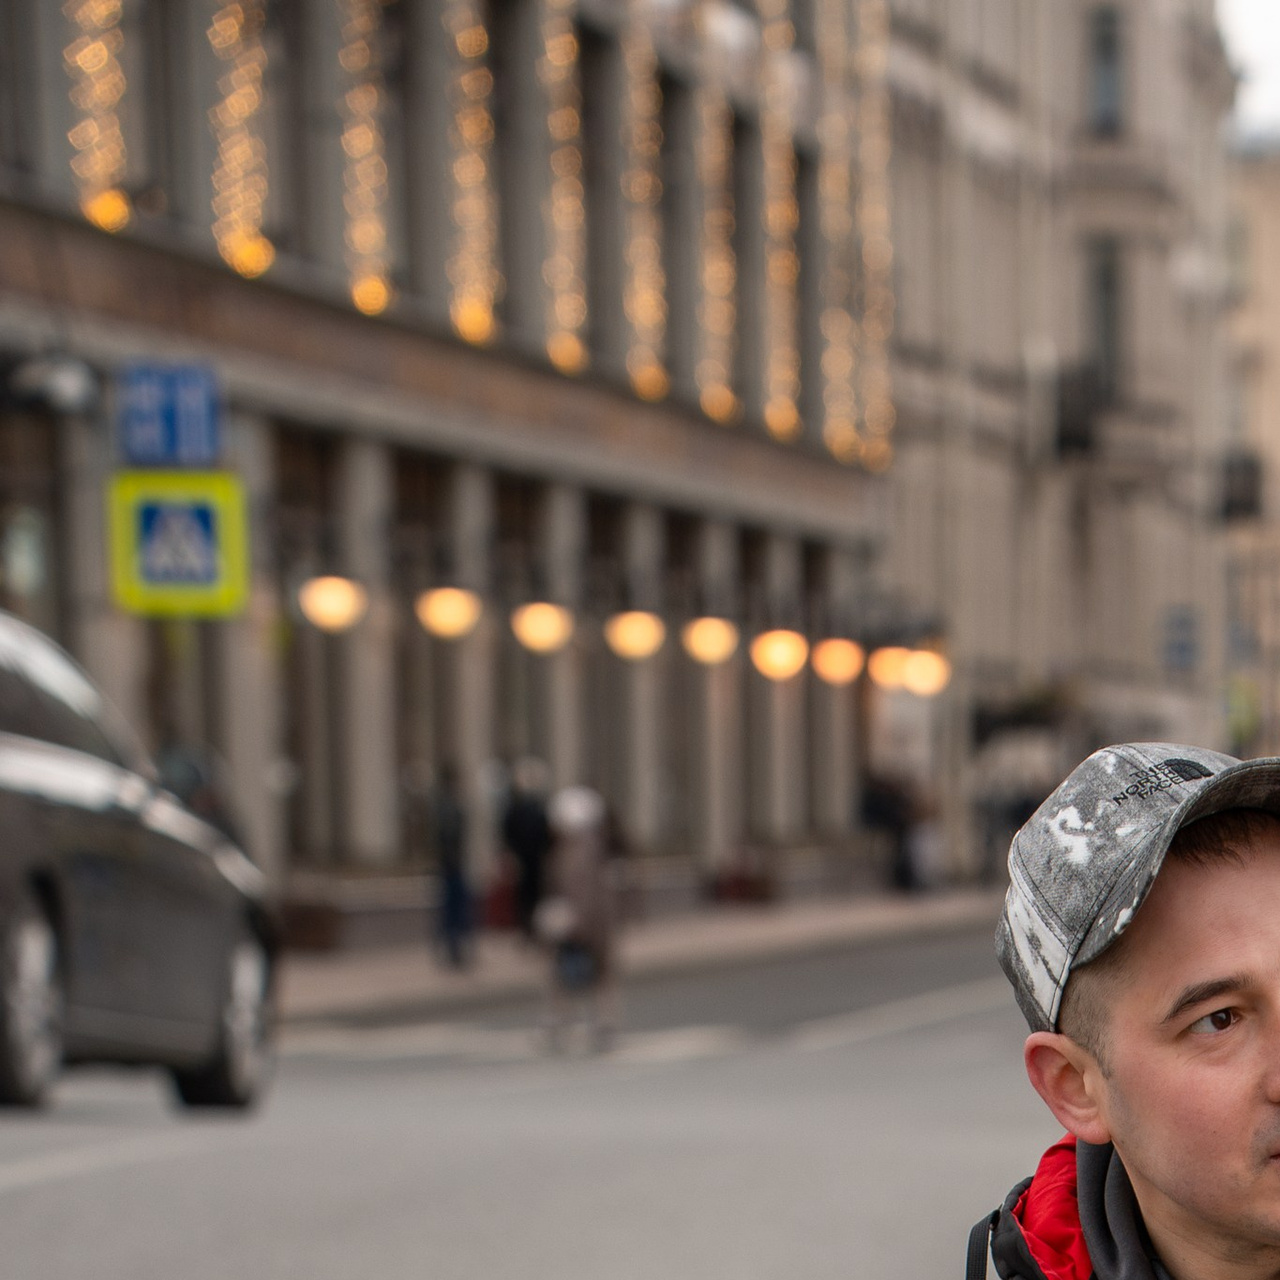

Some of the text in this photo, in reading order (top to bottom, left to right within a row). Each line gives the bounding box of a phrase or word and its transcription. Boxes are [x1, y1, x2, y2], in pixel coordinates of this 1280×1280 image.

[1129, 761, 1168, 779] THE
[1113, 767, 1176, 805] NORTH
[1138, 776, 1184, 799] FACE
